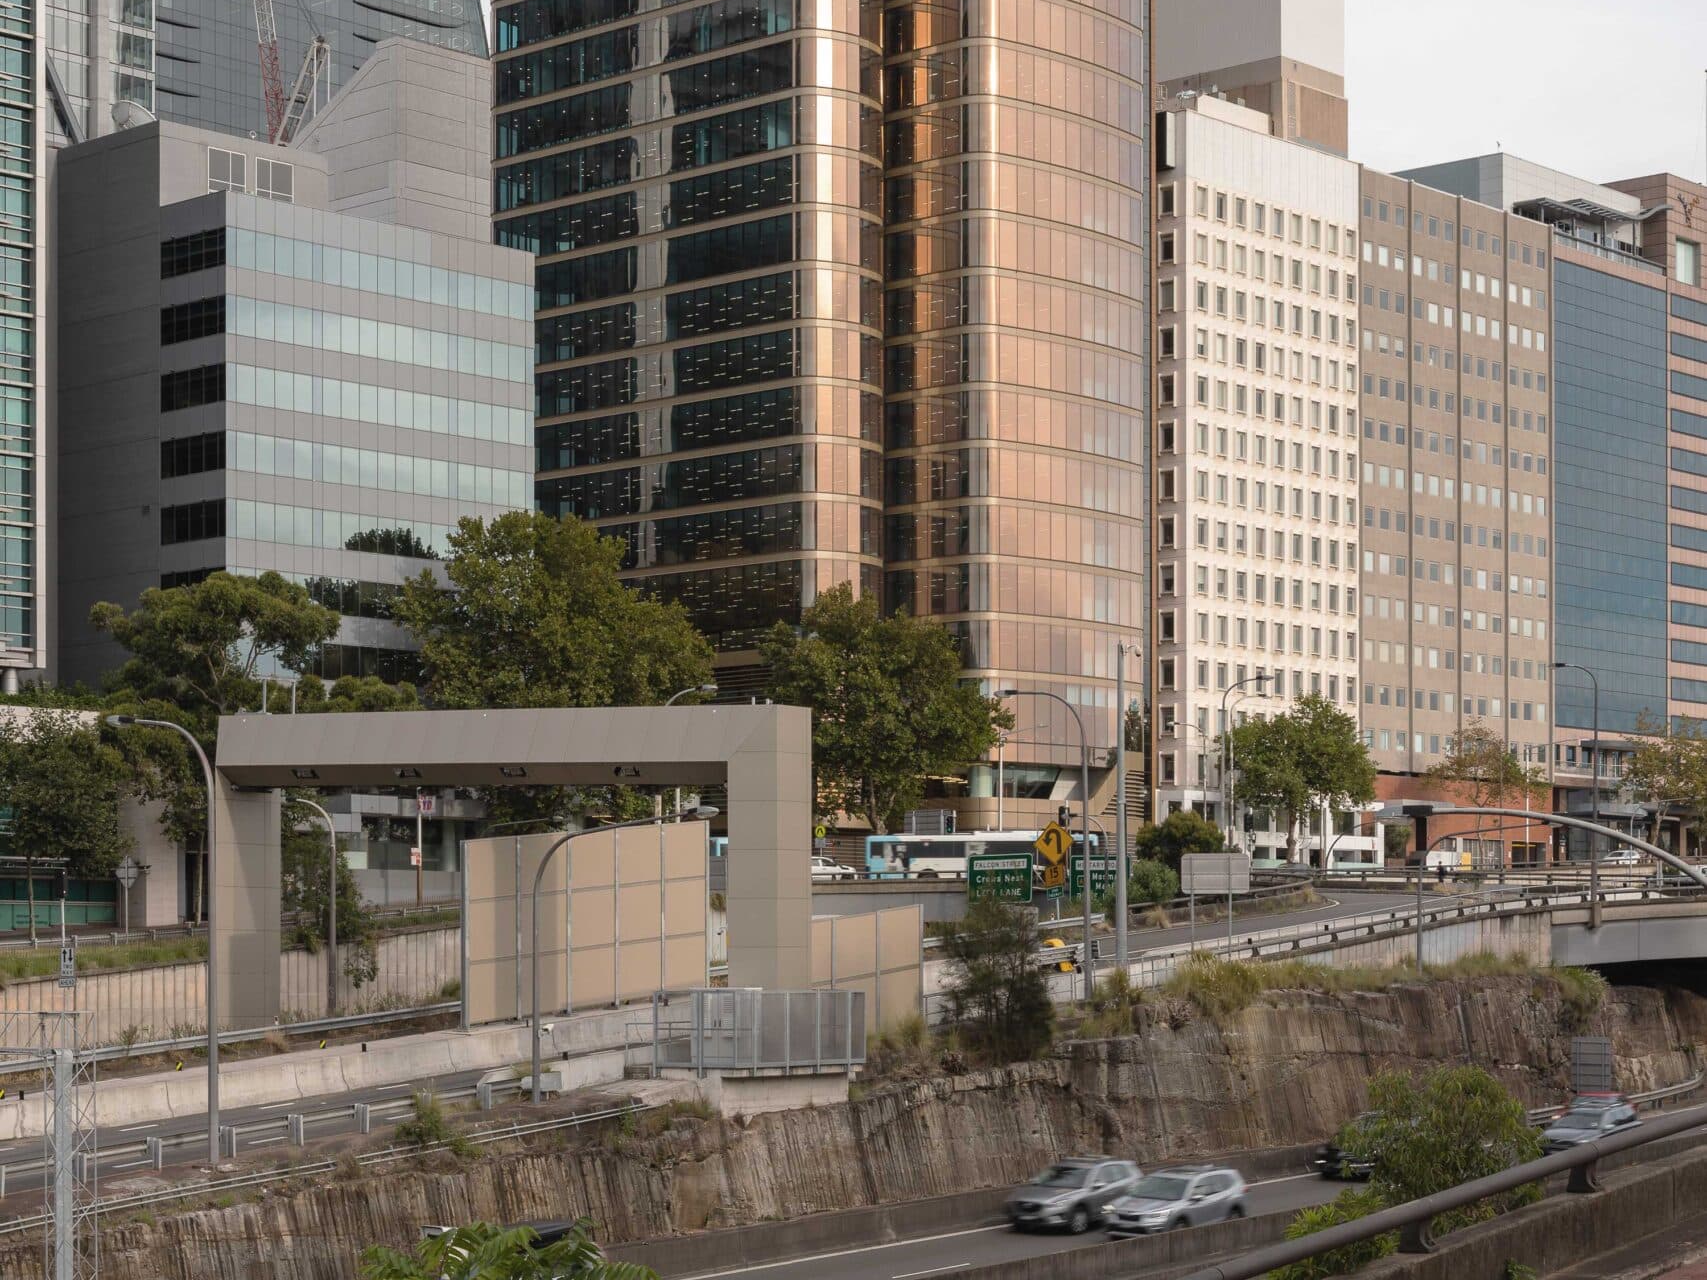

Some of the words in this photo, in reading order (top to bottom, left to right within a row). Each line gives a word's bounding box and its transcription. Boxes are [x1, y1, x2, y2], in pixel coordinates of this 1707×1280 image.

[1050, 866, 1059, 878] 15
[1004, 873, 1024, 883] Nest
[1000, 887, 1022, 896] LANE
